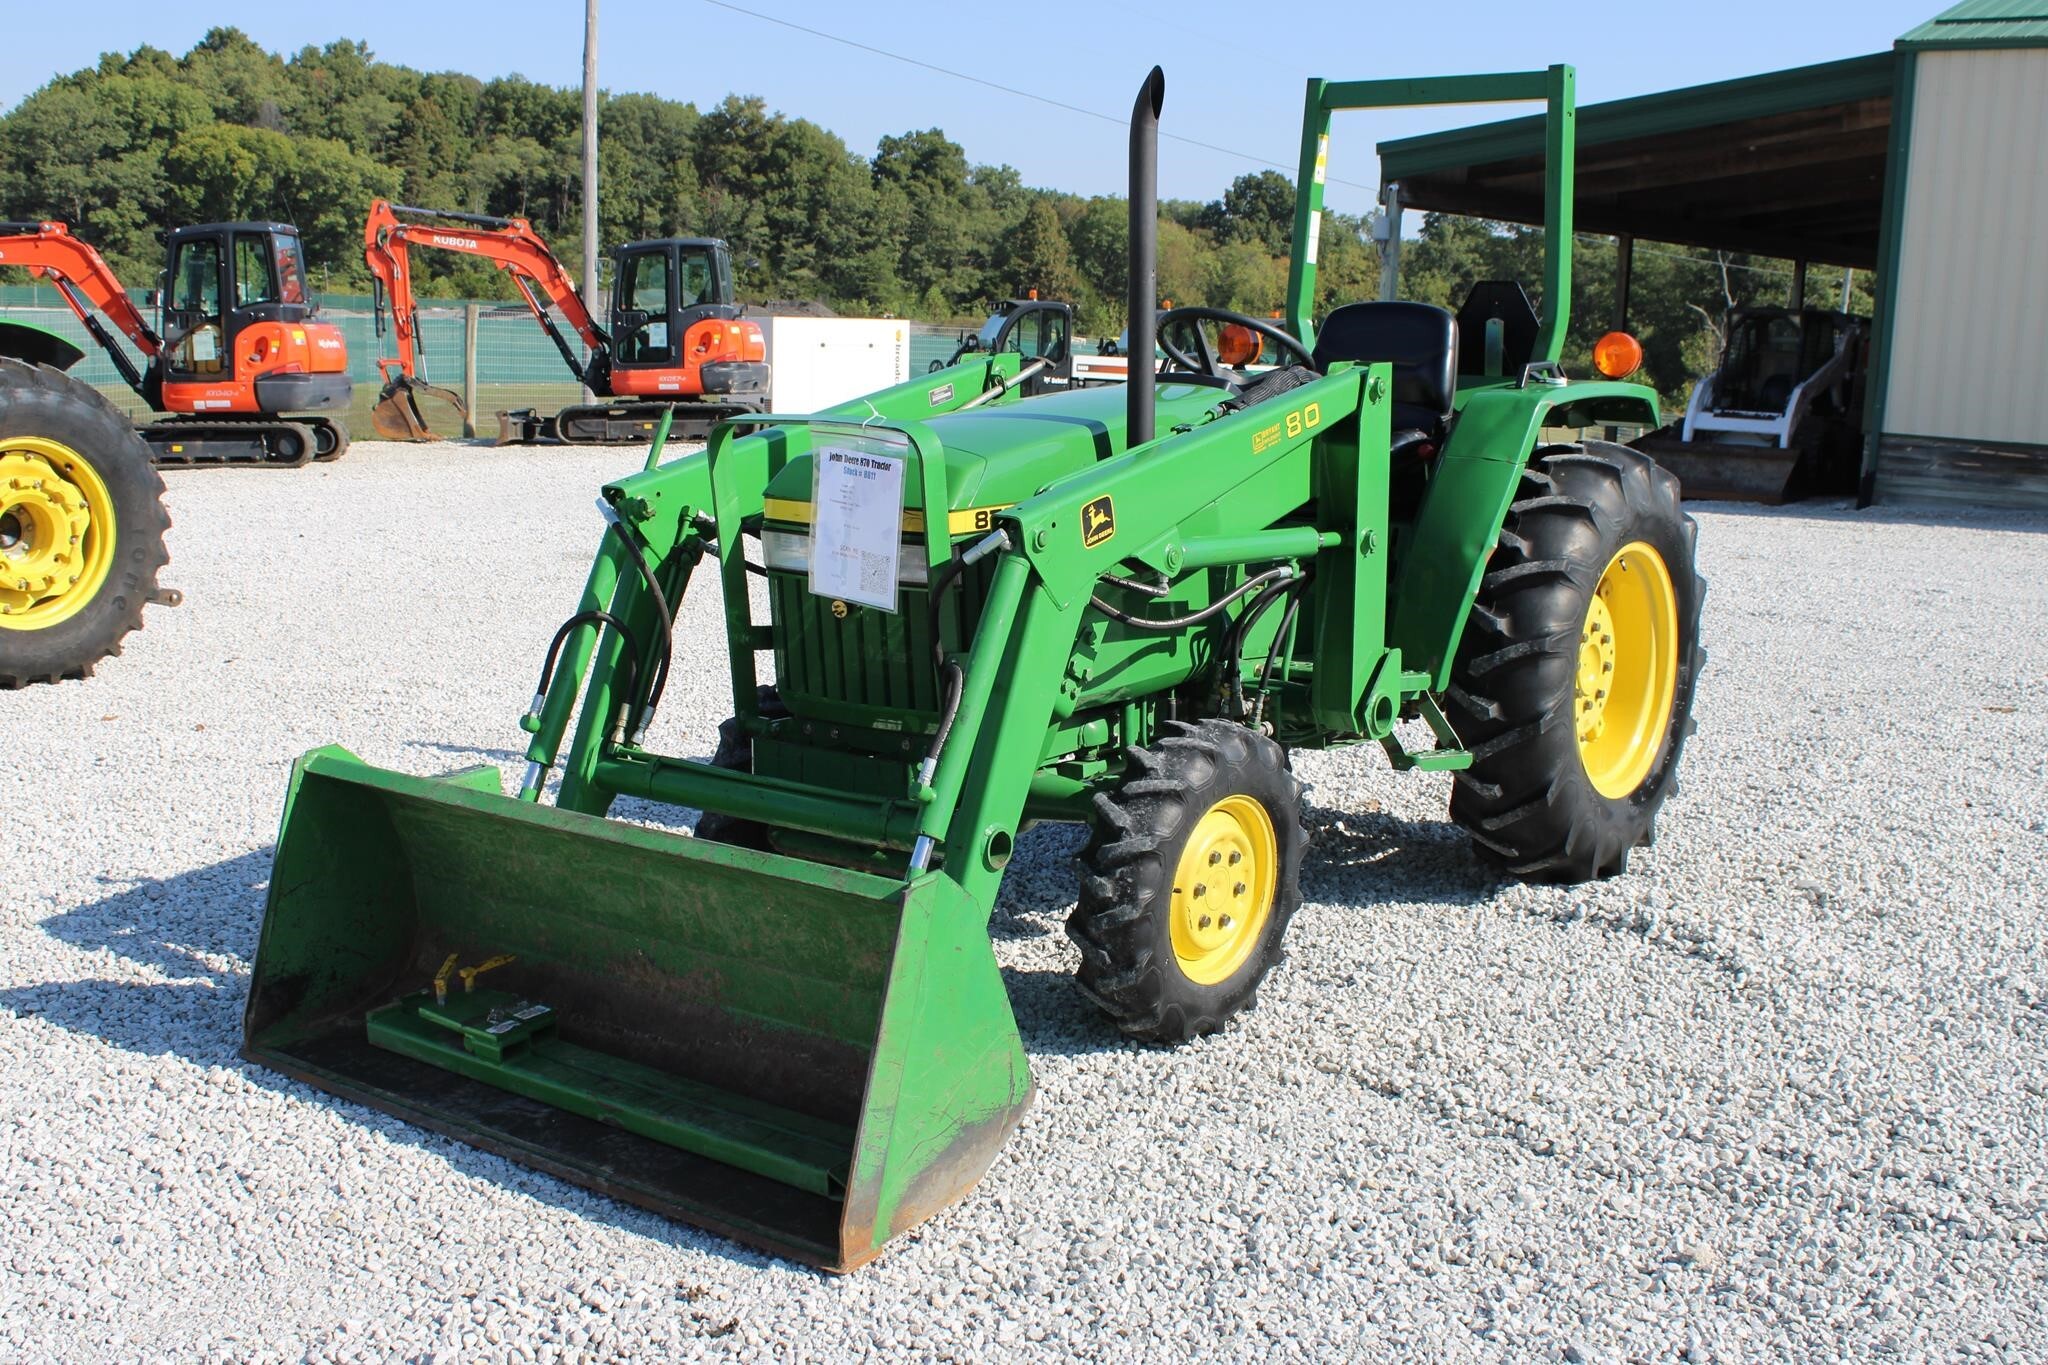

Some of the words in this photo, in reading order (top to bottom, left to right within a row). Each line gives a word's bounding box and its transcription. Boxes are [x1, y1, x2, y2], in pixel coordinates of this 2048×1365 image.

[433, 234, 477, 248] KUBOTA
[1285, 402, 1320, 439] 80
[829, 452, 843, 462] John
[844, 454, 860, 466] Deere
[860, 457, 871, 468] 870
[871, 459, 892, 471] Tractor
[1086, 534, 1099, 545] JOHN
[1098, 527, 1113, 539] DEERE
